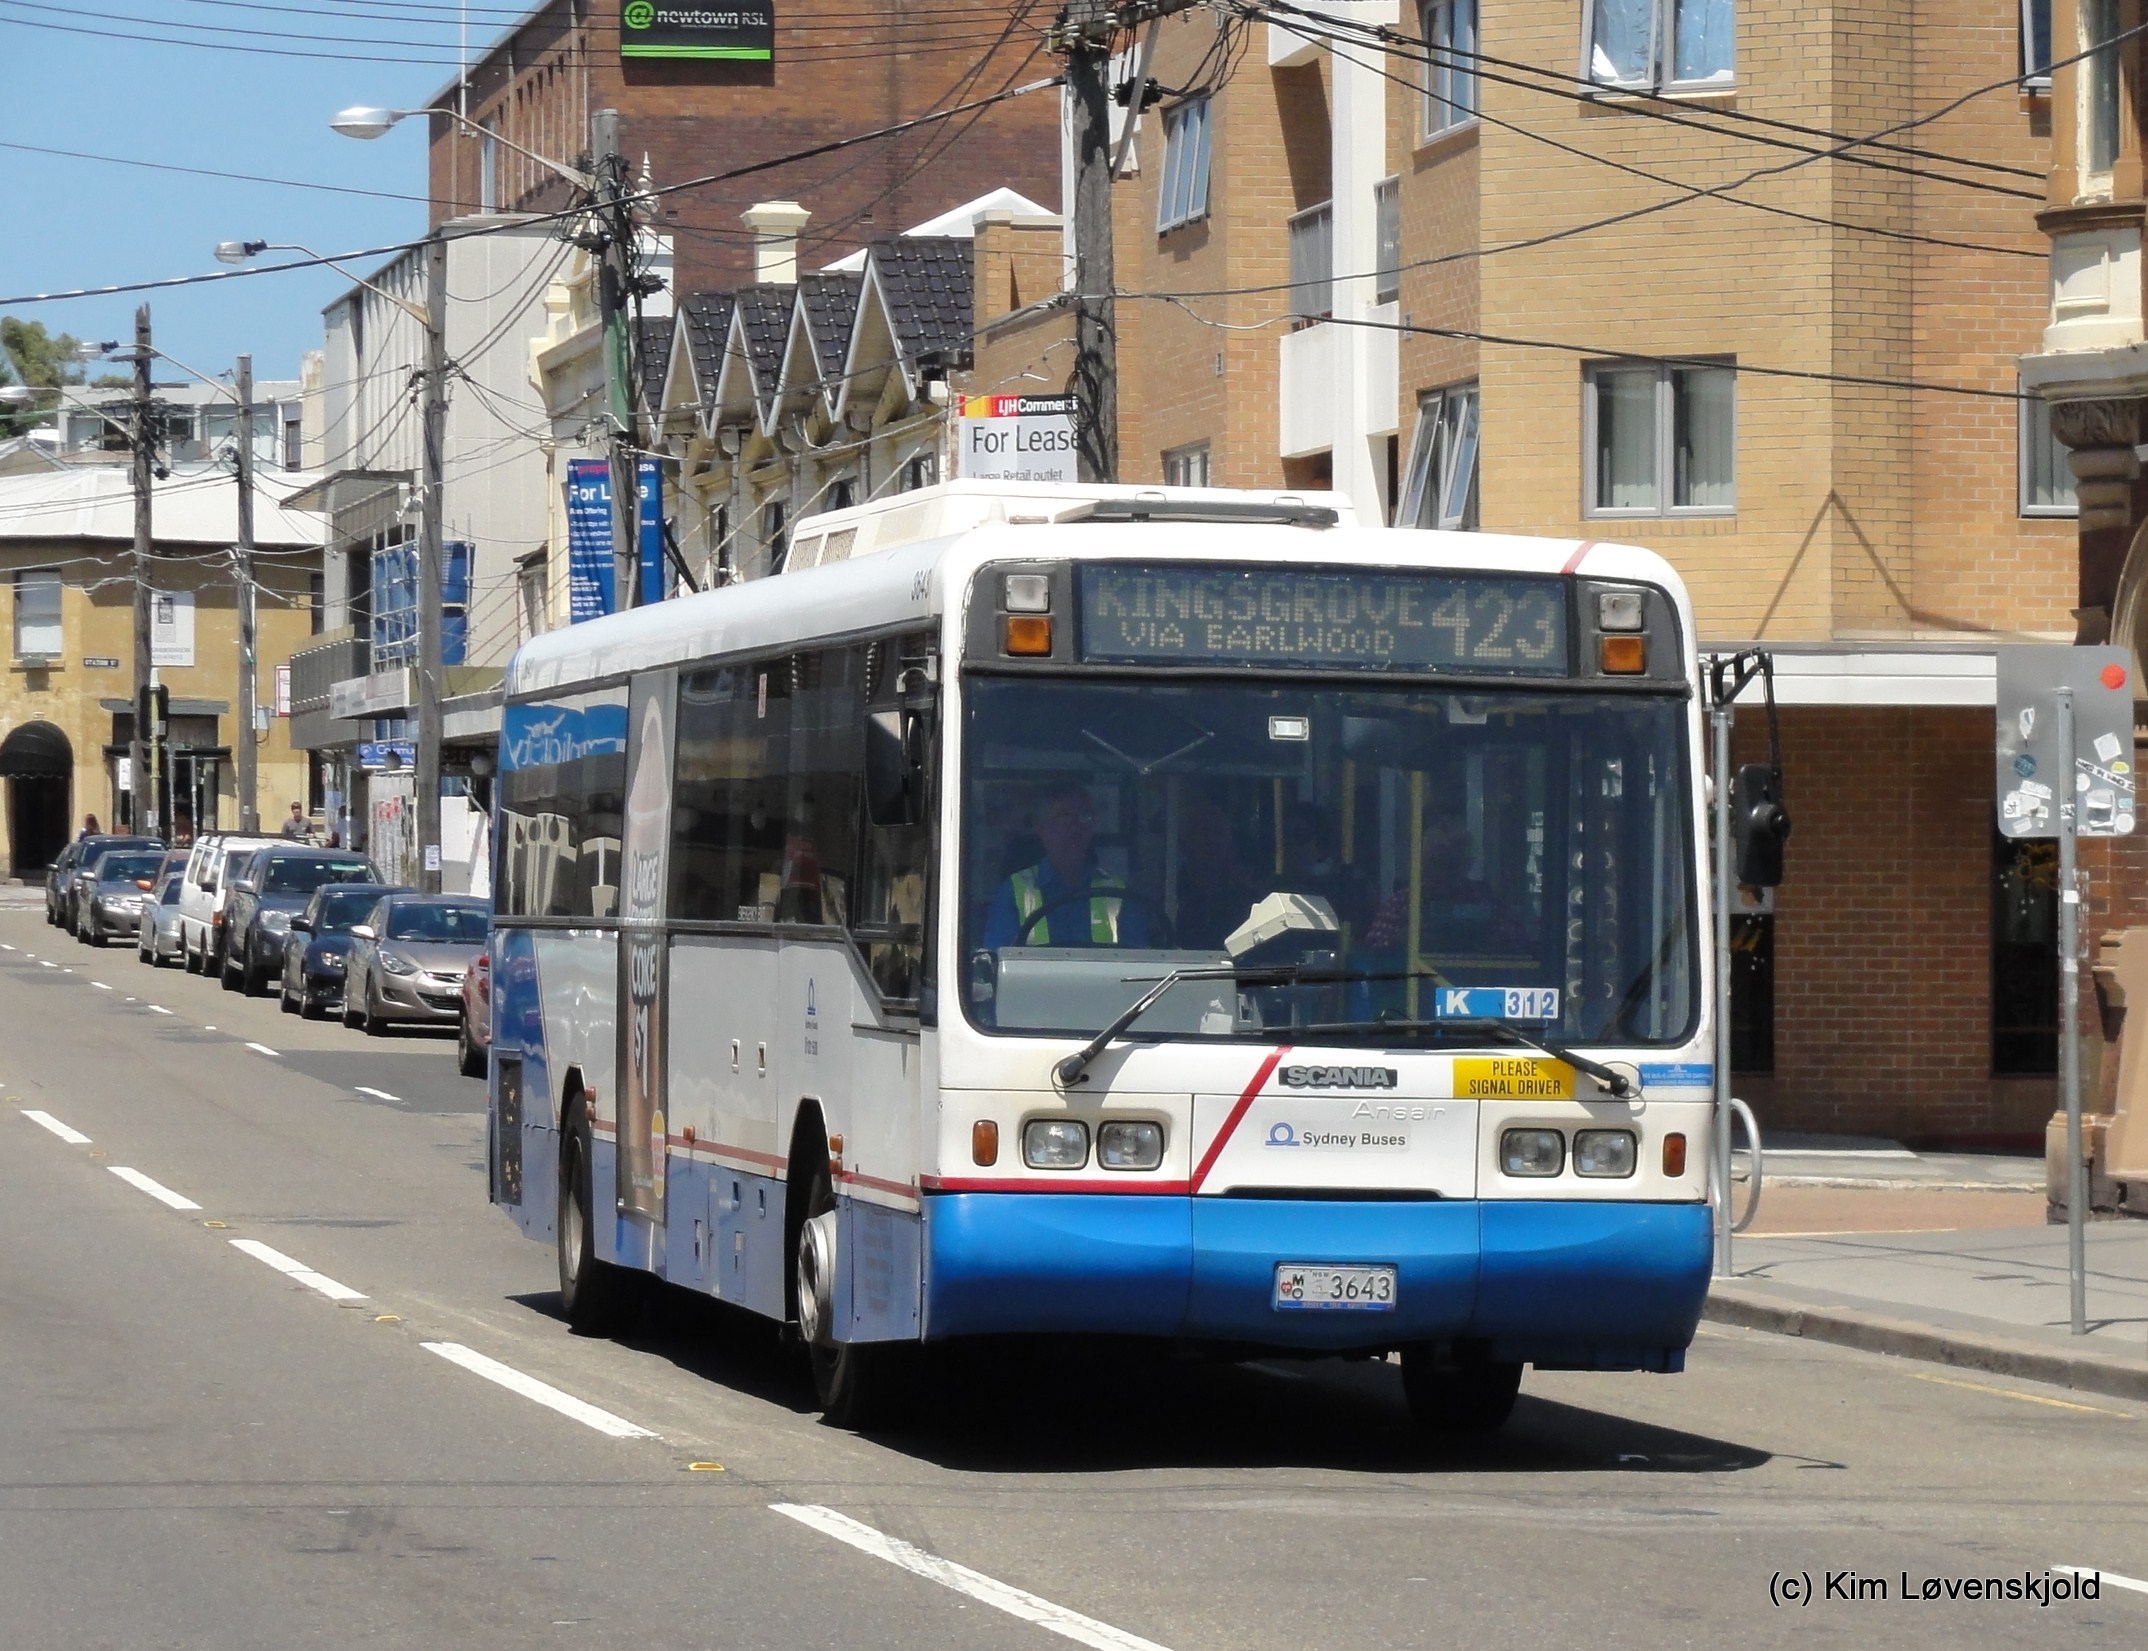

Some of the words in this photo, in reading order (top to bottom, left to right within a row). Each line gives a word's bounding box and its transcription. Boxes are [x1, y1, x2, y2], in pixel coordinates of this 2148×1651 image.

[657, 10, 738, 24] newtown
[742, 12, 768, 26] RSL
[972, 426, 1009, 453] For
[1016, 424, 1079, 453] Lease
[1003, 468, 1031, 480] Retail
[1034, 467, 1063, 481] outlet
[569, 485, 597, 501] For
[1097, 577, 1424, 628] KINGSGROVE
[1431, 587, 1556, 659] 423
[1120, 621, 1185, 649] VIA
[1207, 623, 1394, 656] EARLWOOD
[632, 855, 658, 901] LARGE
[631, 944, 656, 998] COKE
[1446, 990, 1470, 1015] K
[1507, 991, 1555, 1016] 312
[634, 1004, 649, 1098] $1
[1286, 1066, 1390, 1087] SCANIA
[1492, 1061, 1538, 1076] PLEASE
[1469, 1079, 1513, 1095] SIGNAL
[1518, 1079, 1561, 1095] DRIVER
[1351, 1100, 1446, 1121] Ansair
[1303, 1131, 1356, 1148] Sydney
[1361, 1133, 1406, 1146] Buses
[1330, 1274, 1391, 1301] 3643
